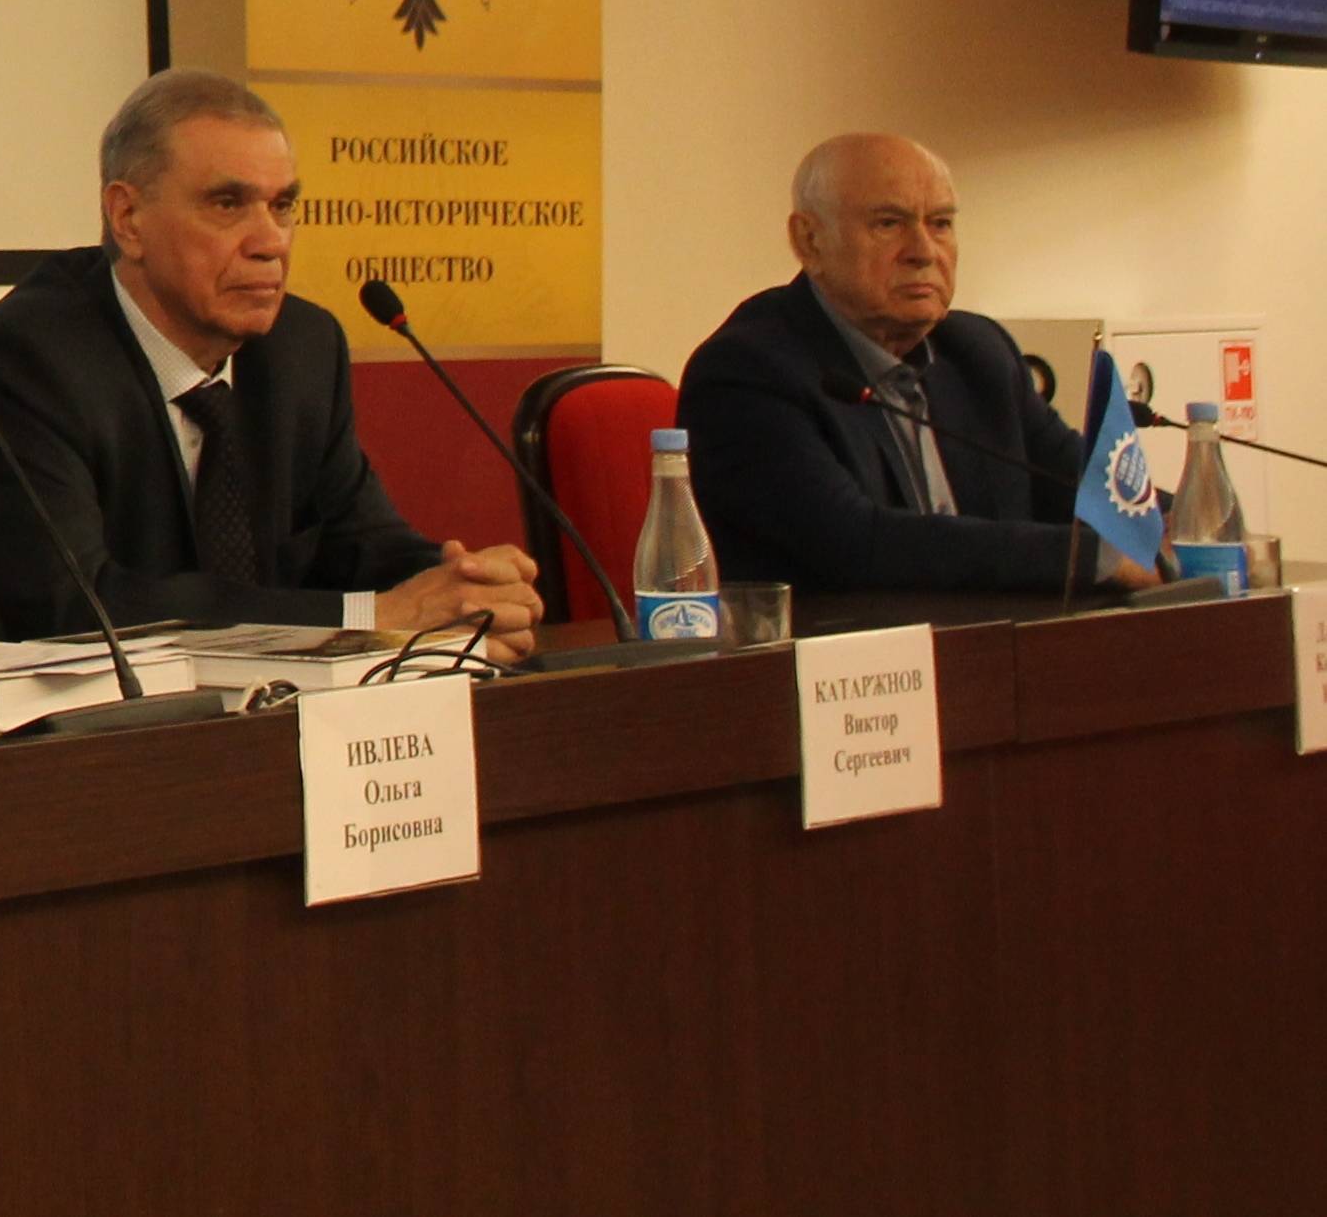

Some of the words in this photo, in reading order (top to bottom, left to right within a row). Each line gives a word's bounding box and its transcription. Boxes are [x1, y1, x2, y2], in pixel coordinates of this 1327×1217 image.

[330, 133, 509, 167] РОССИЙСКОЕ
[345, 256, 494, 287] ОБЩЕСТВО
[815, 669, 923, 704] КАТАРЖНОВ
[844, 712, 899, 735] Виктор
[346, 733, 434, 767] ИВЛЕВА
[833, 746, 911, 776] Сергеевич
[364, 779, 423, 805] Ольга
[343, 816, 444, 853] Борисовна
